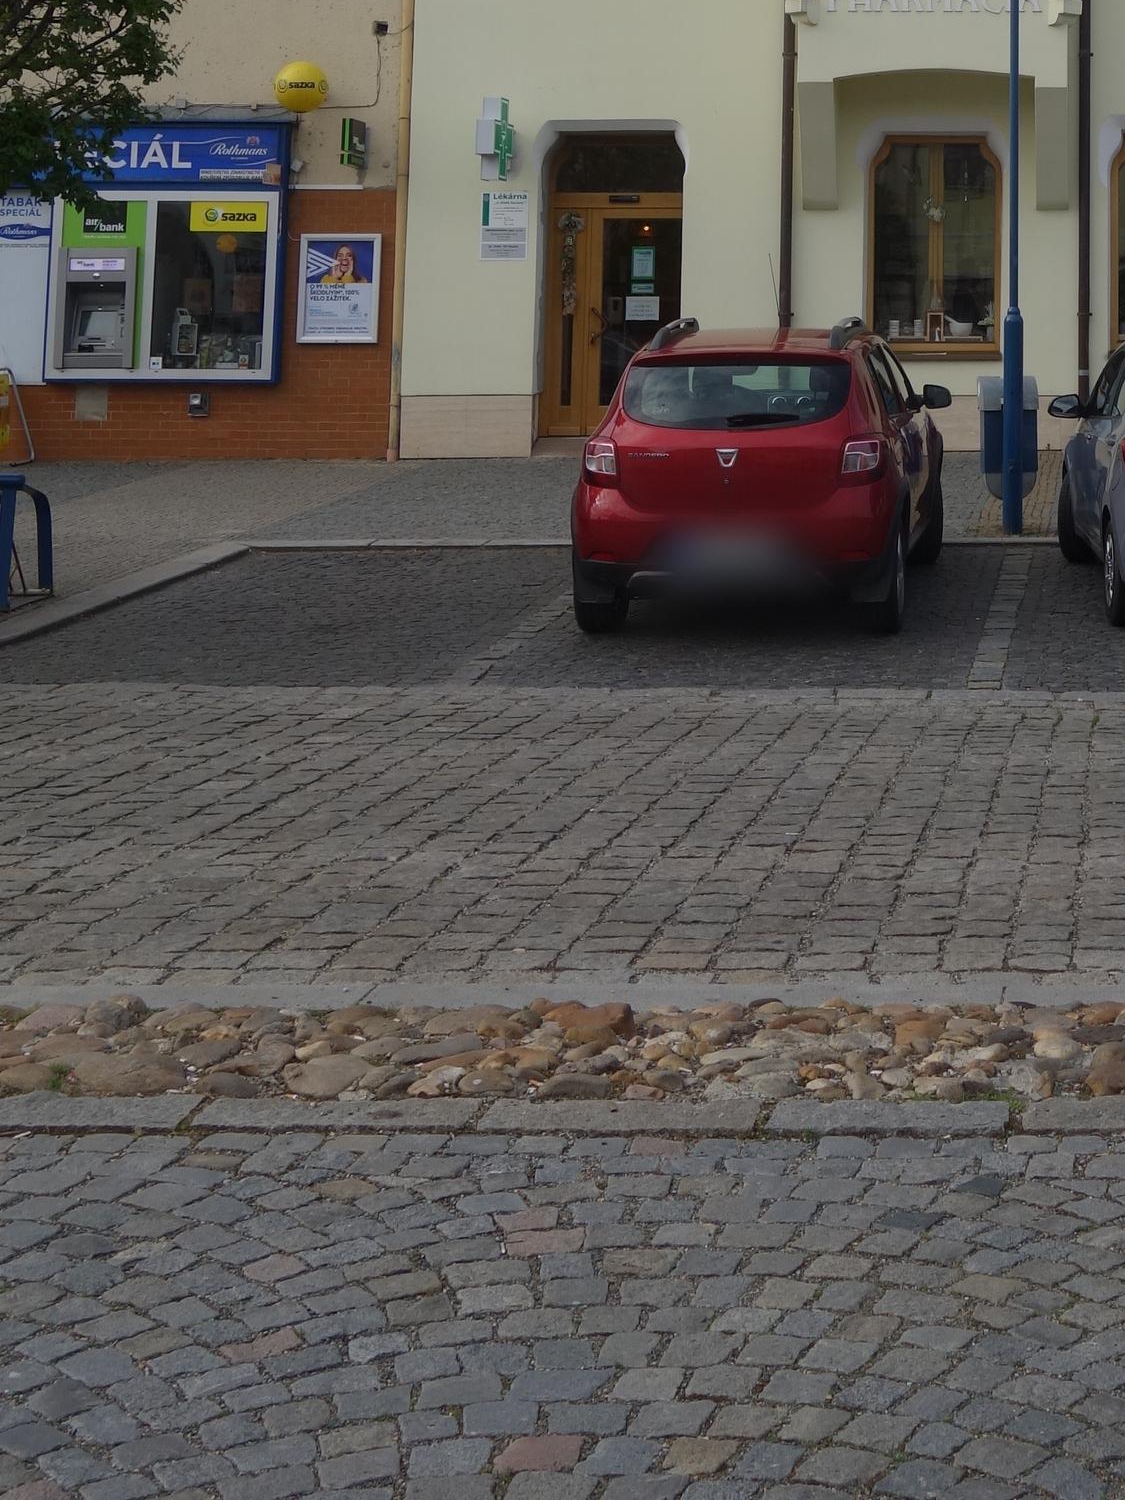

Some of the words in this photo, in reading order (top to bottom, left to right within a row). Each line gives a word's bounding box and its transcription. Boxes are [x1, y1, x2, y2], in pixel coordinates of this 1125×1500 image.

[53, 133, 192, 169] CIÁL
[209, 142, 269, 156] Rothmans
[493, 192, 528, 200] Lékárna
[0, 207, 42, 217] SPECIÁL
[85, 218, 98, 226] air
[99, 223, 124, 232] bank
